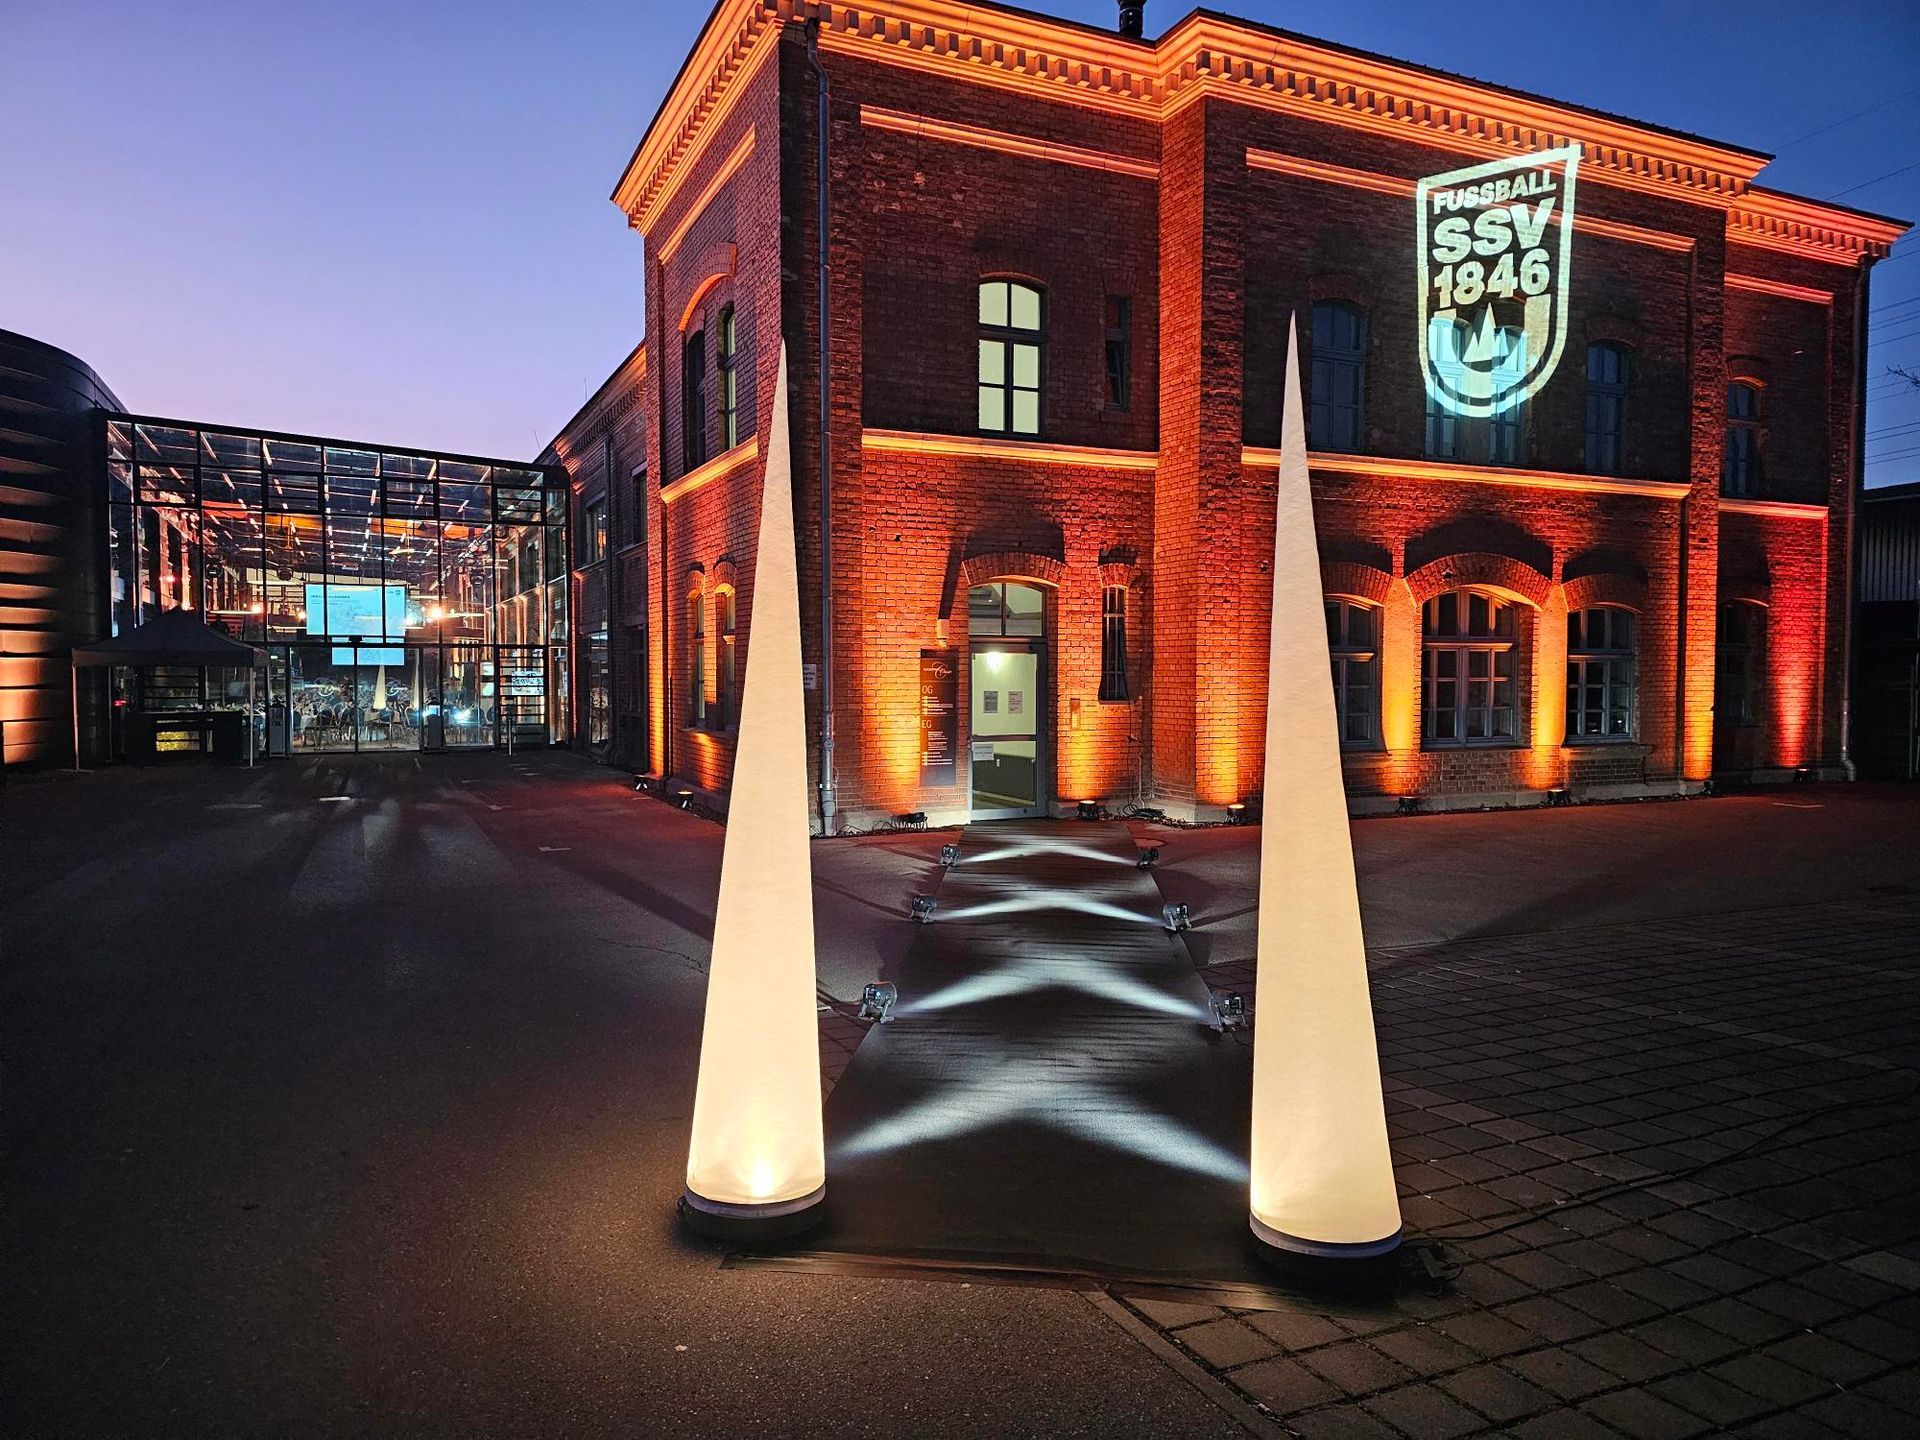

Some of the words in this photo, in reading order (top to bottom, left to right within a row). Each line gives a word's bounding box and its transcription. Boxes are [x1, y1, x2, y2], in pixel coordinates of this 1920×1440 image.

[1433, 169, 1557, 214] FUSSBALL
[1432, 197, 1556, 263] SSV
[1434, 248, 1551, 308] 1846
[921, 684, 933, 694] OG
[922, 720, 932, 729] EG
